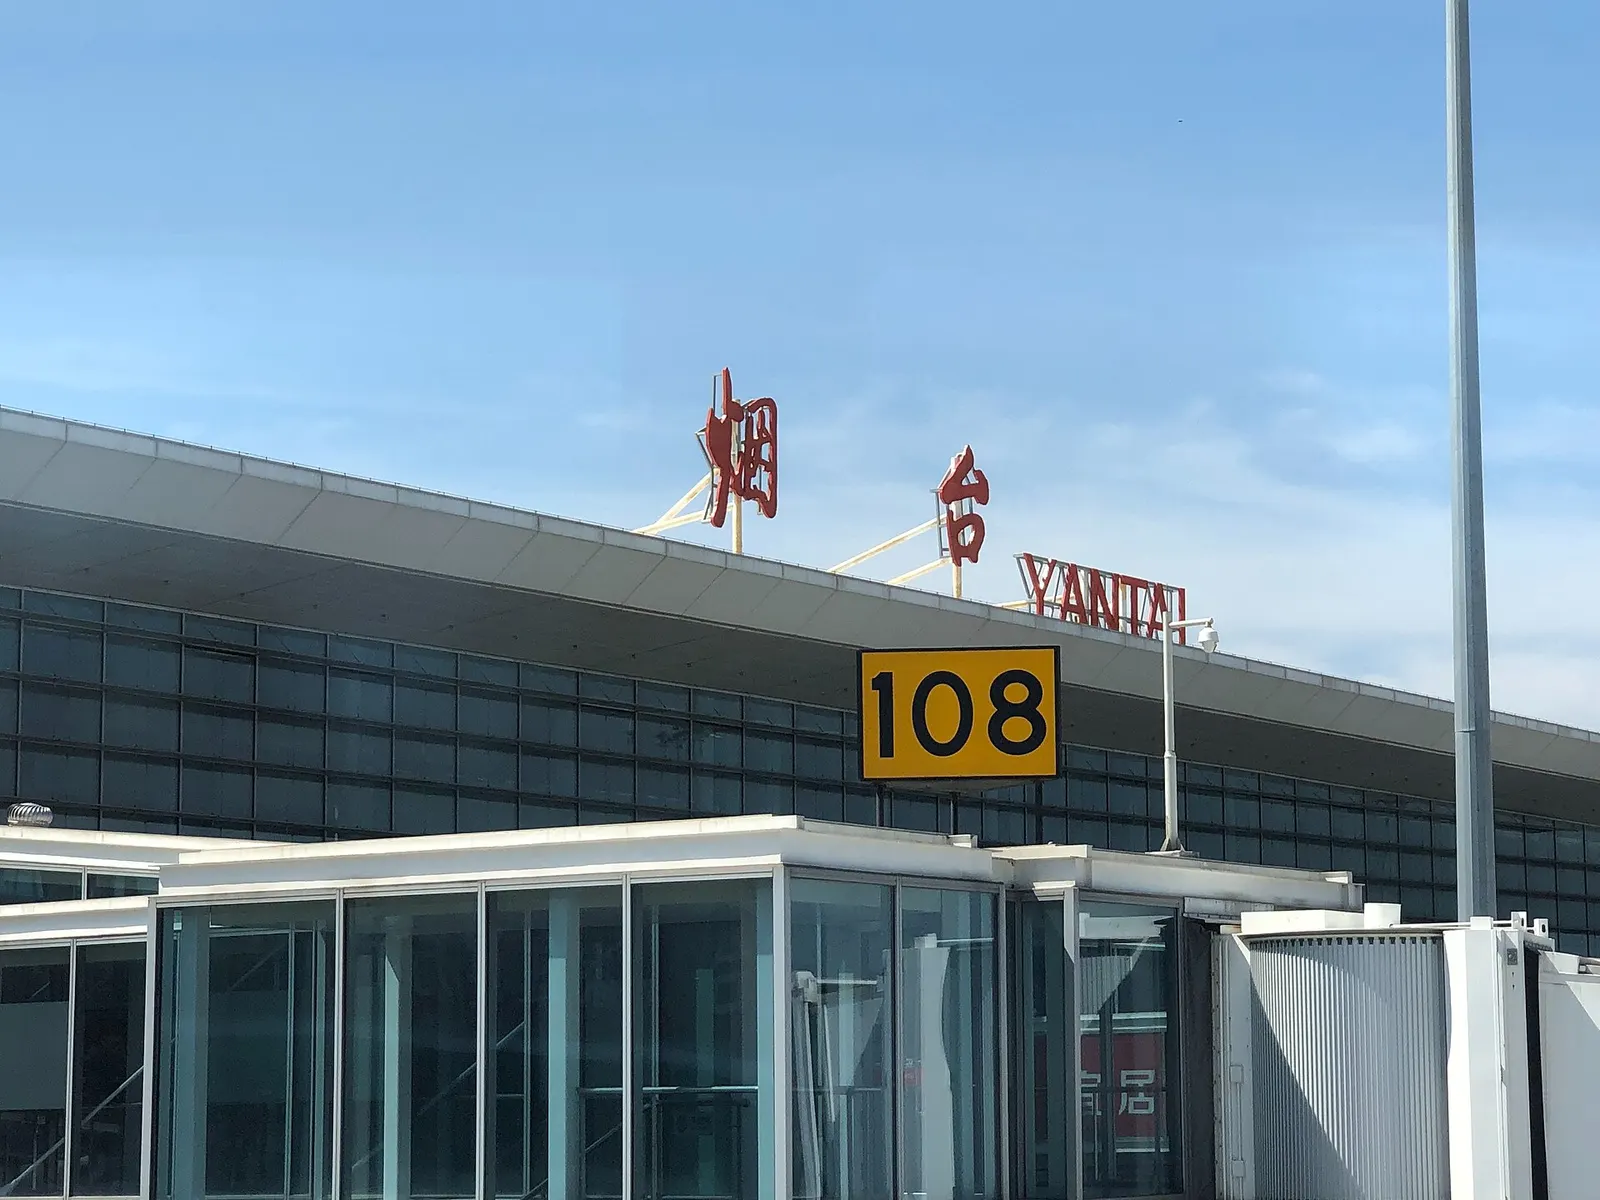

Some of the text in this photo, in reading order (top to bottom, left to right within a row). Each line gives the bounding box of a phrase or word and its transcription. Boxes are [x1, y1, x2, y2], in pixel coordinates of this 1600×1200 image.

[705, 367, 990, 567] 烟台
[1023, 552, 1186, 645] YANTAI
[871, 669, 1048, 759] 108
